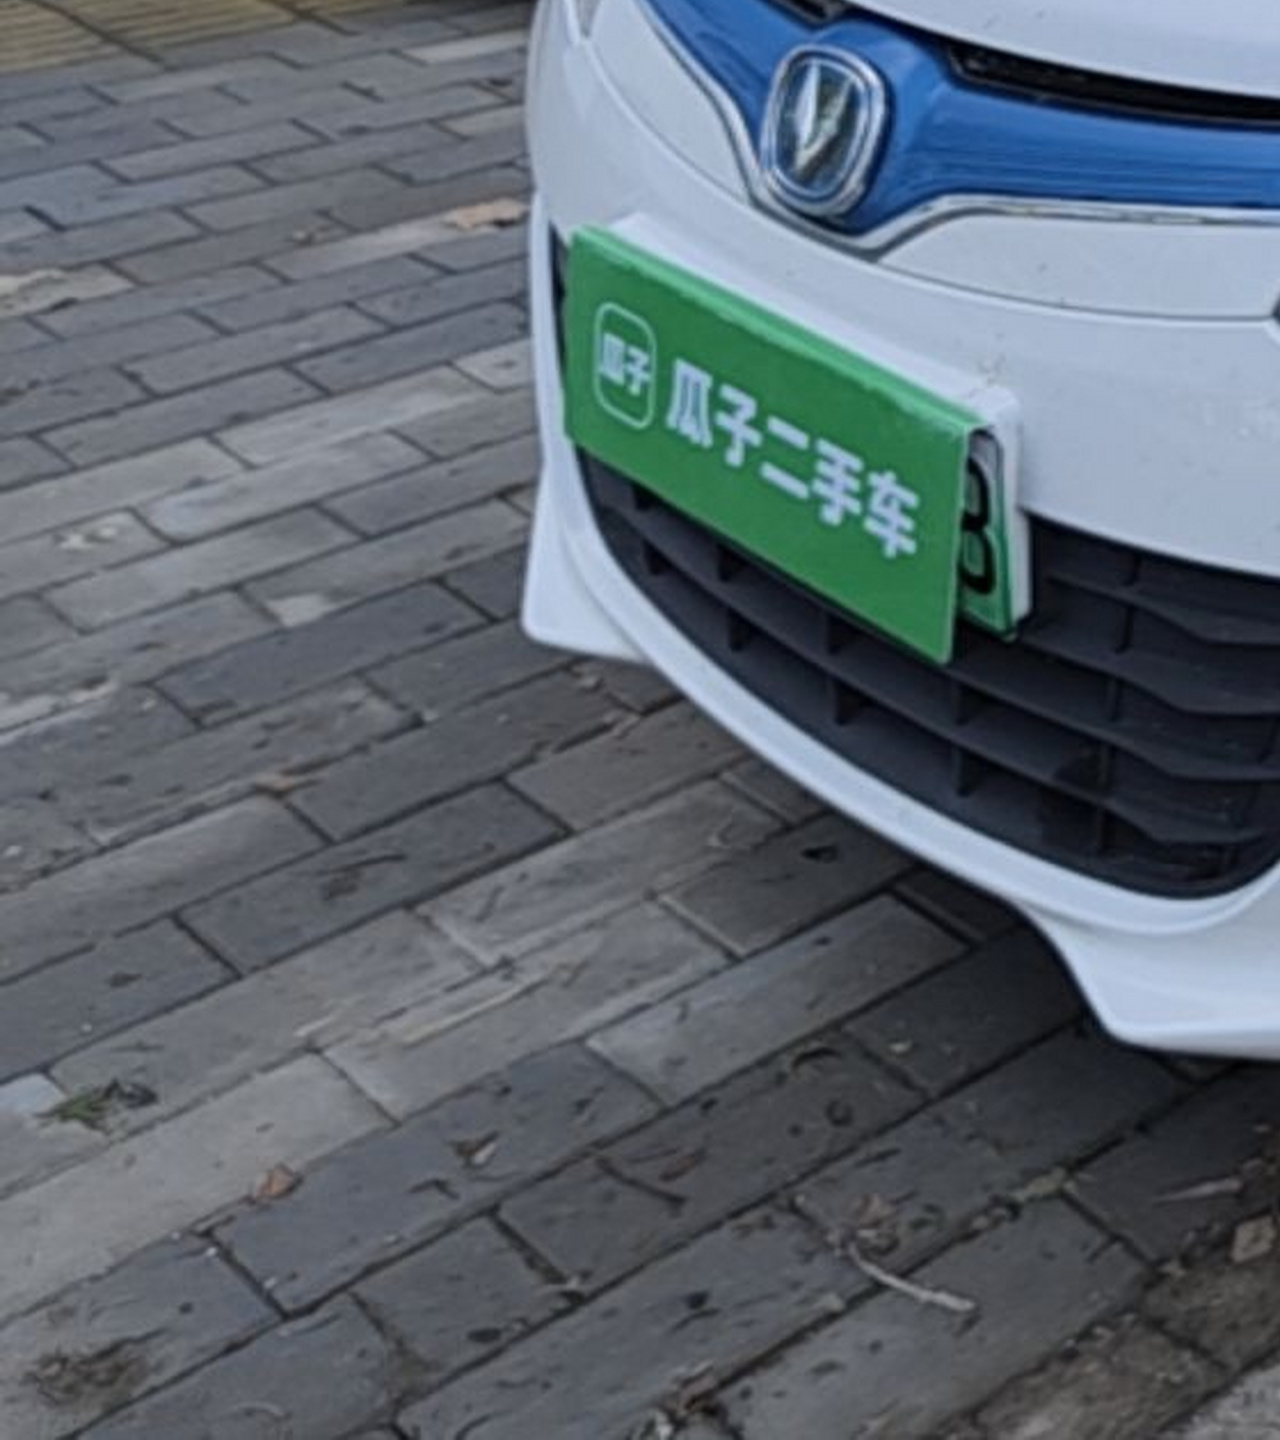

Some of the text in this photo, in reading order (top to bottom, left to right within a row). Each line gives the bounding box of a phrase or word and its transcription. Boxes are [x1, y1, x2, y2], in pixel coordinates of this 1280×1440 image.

[600, 332, 651, 396] 瓜子
[667, 359, 918, 557] 瓜子二手车
